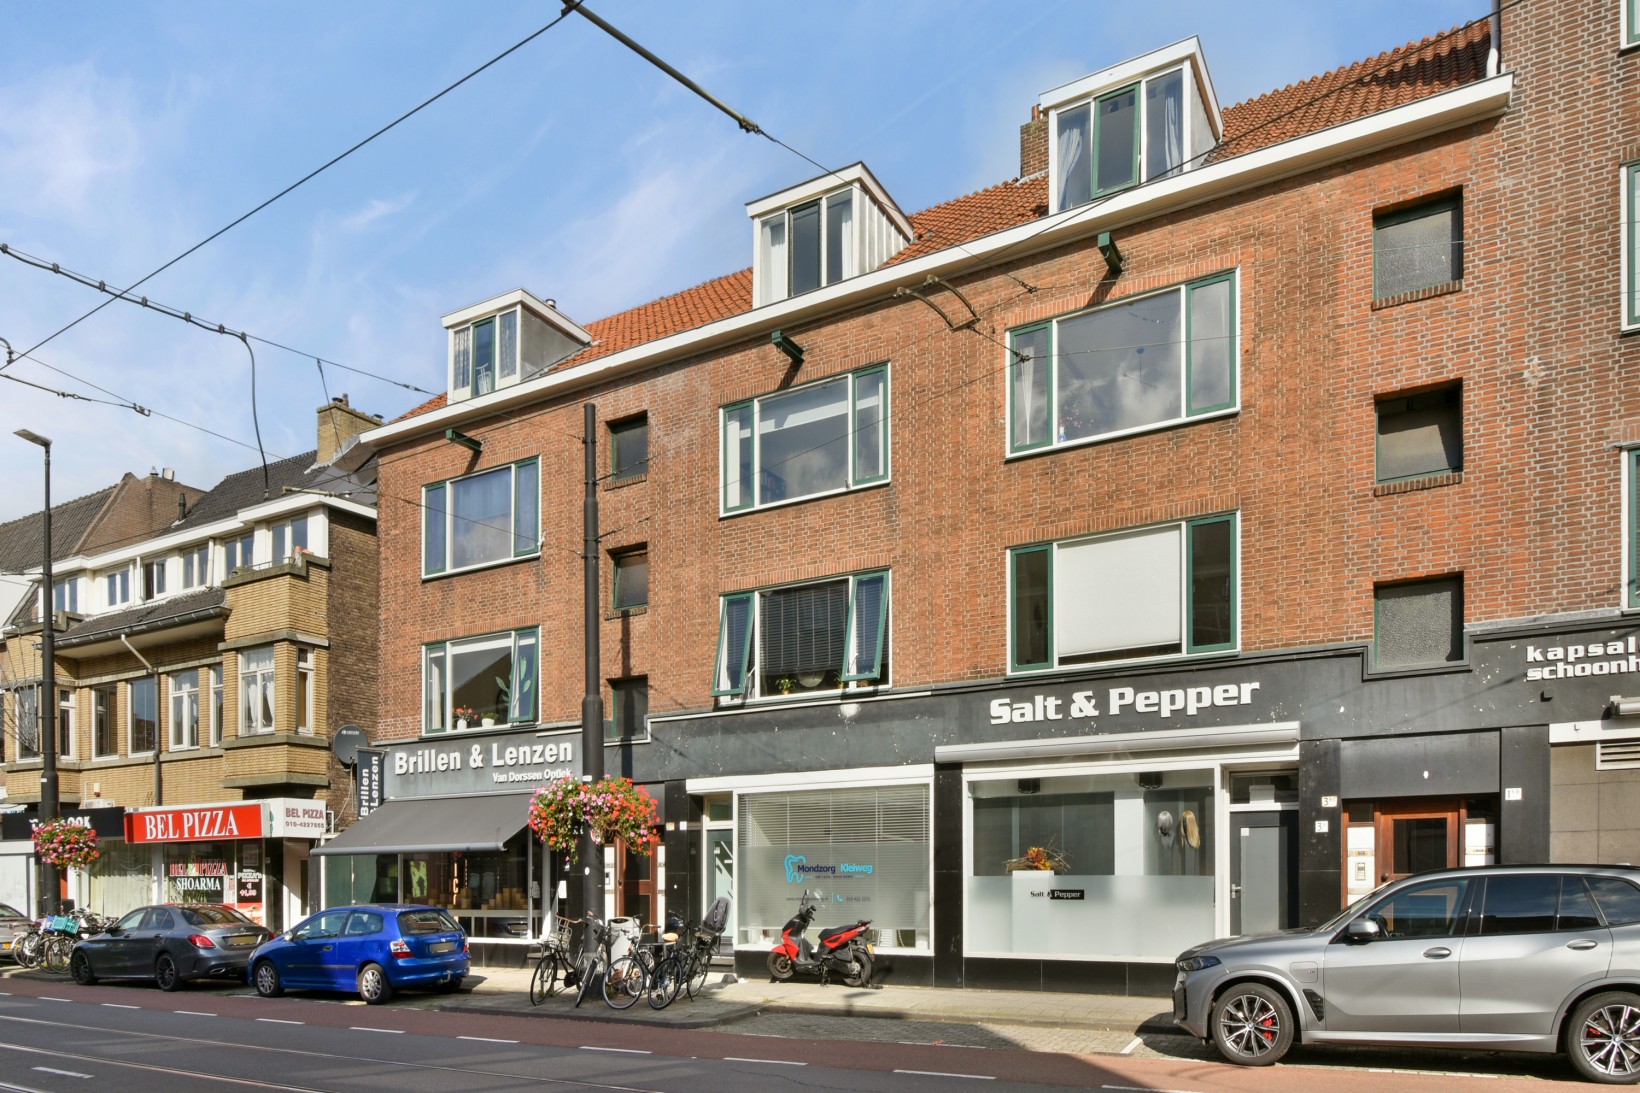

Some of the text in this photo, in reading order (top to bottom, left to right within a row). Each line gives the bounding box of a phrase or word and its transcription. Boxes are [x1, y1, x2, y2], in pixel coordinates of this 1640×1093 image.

[1526, 636, 1636, 662] kapsal
[989, 681, 1260, 725] Salt & Pepper
[394, 742, 573, 775] Brillen & Lenzen
[370, 756, 379, 807] Lenzen
[492, 768, 573, 784] Van Dorssen Optiek
[360, 768, 369, 816] Brillen
[285, 807, 325, 820] BEL PIZZA
[144, 809, 239, 840] BEL PIZZA
[169, 861, 228, 877] BEL PIZZA
[797, 863, 873, 874] Mondzorg Kleiweg
[176, 877, 221, 891] SHOARMA
[1054, 890, 1082, 899] Pepper
